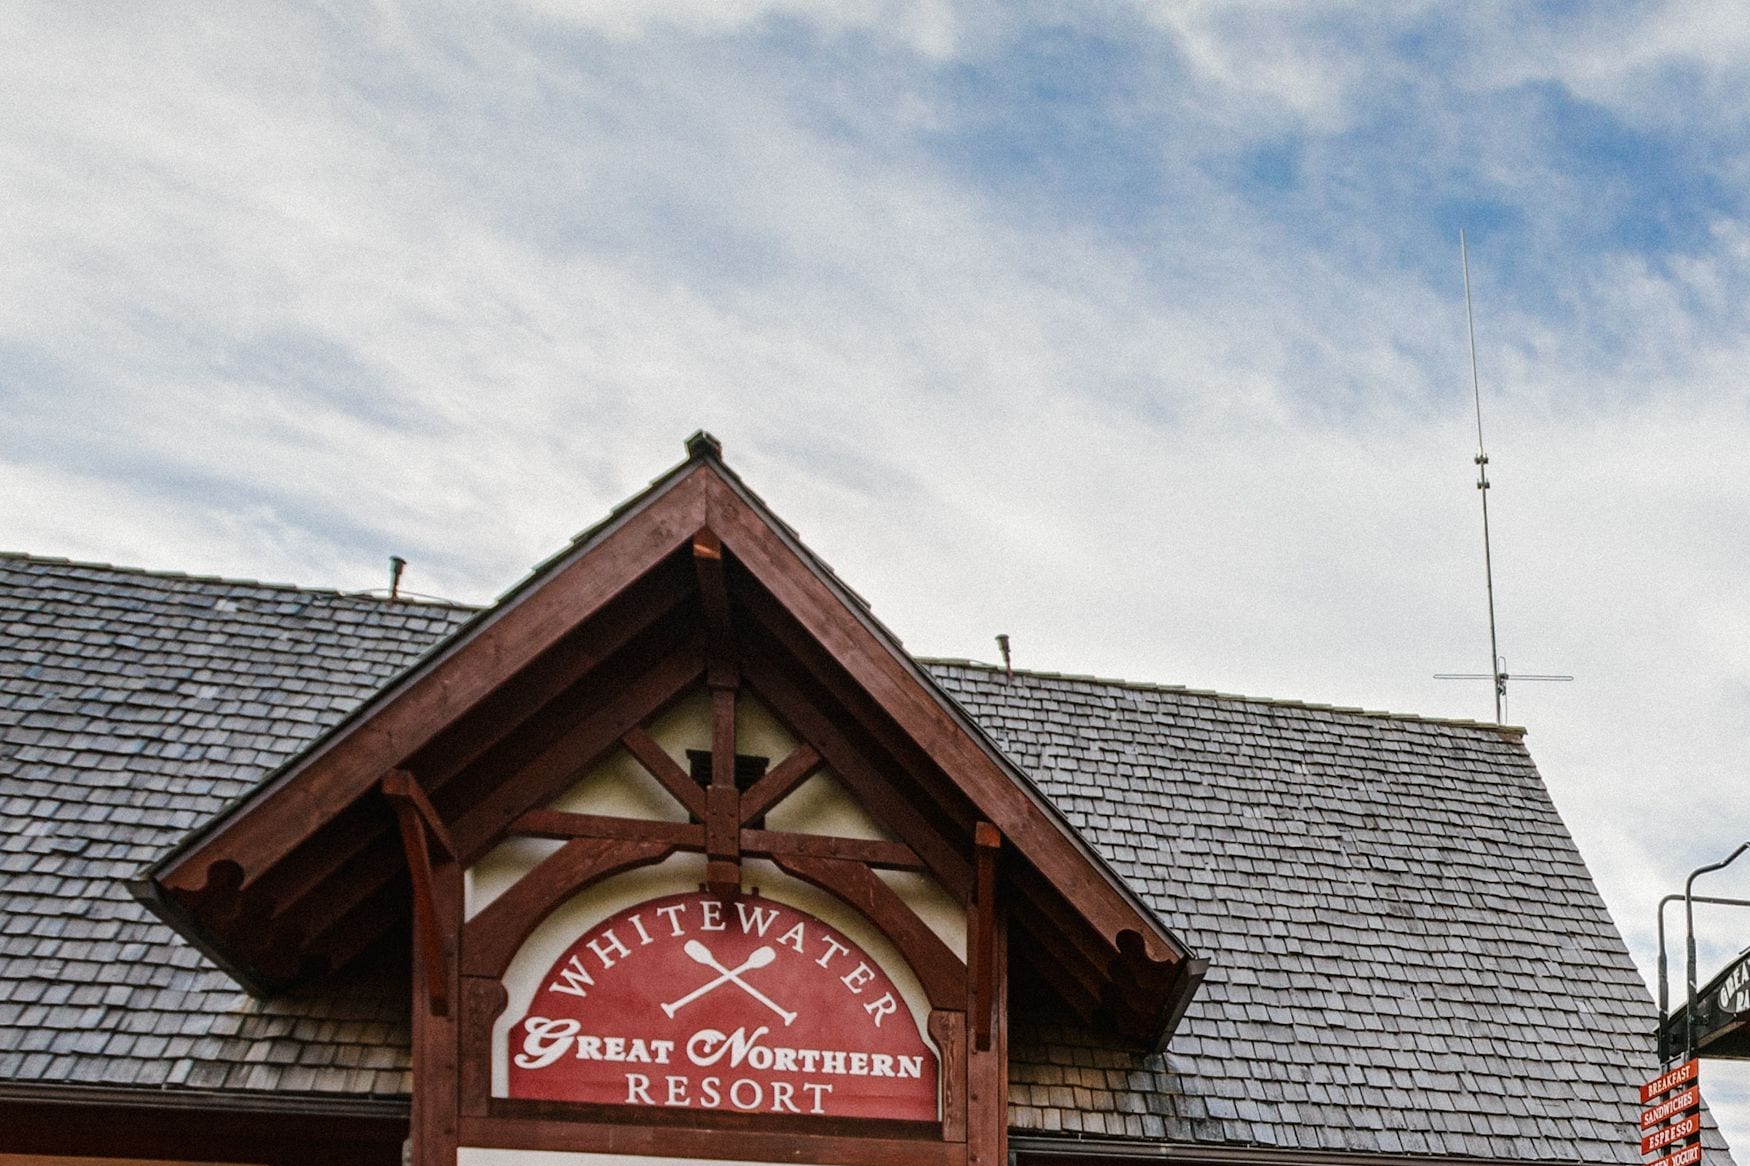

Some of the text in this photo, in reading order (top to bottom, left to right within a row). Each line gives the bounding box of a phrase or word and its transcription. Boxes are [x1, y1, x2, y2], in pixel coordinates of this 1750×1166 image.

[549, 900, 898, 1027] WHITEWATER
[514, 1015, 923, 1079] GREAT NORTHERN
[625, 1072, 833, 1114] RESORT
[1648, 1065, 1691, 1098] BREAKFAST
[1644, 1091, 1693, 1126] SANDWICHES
[1649, 1119, 1693, 1149] ESPRESSO
